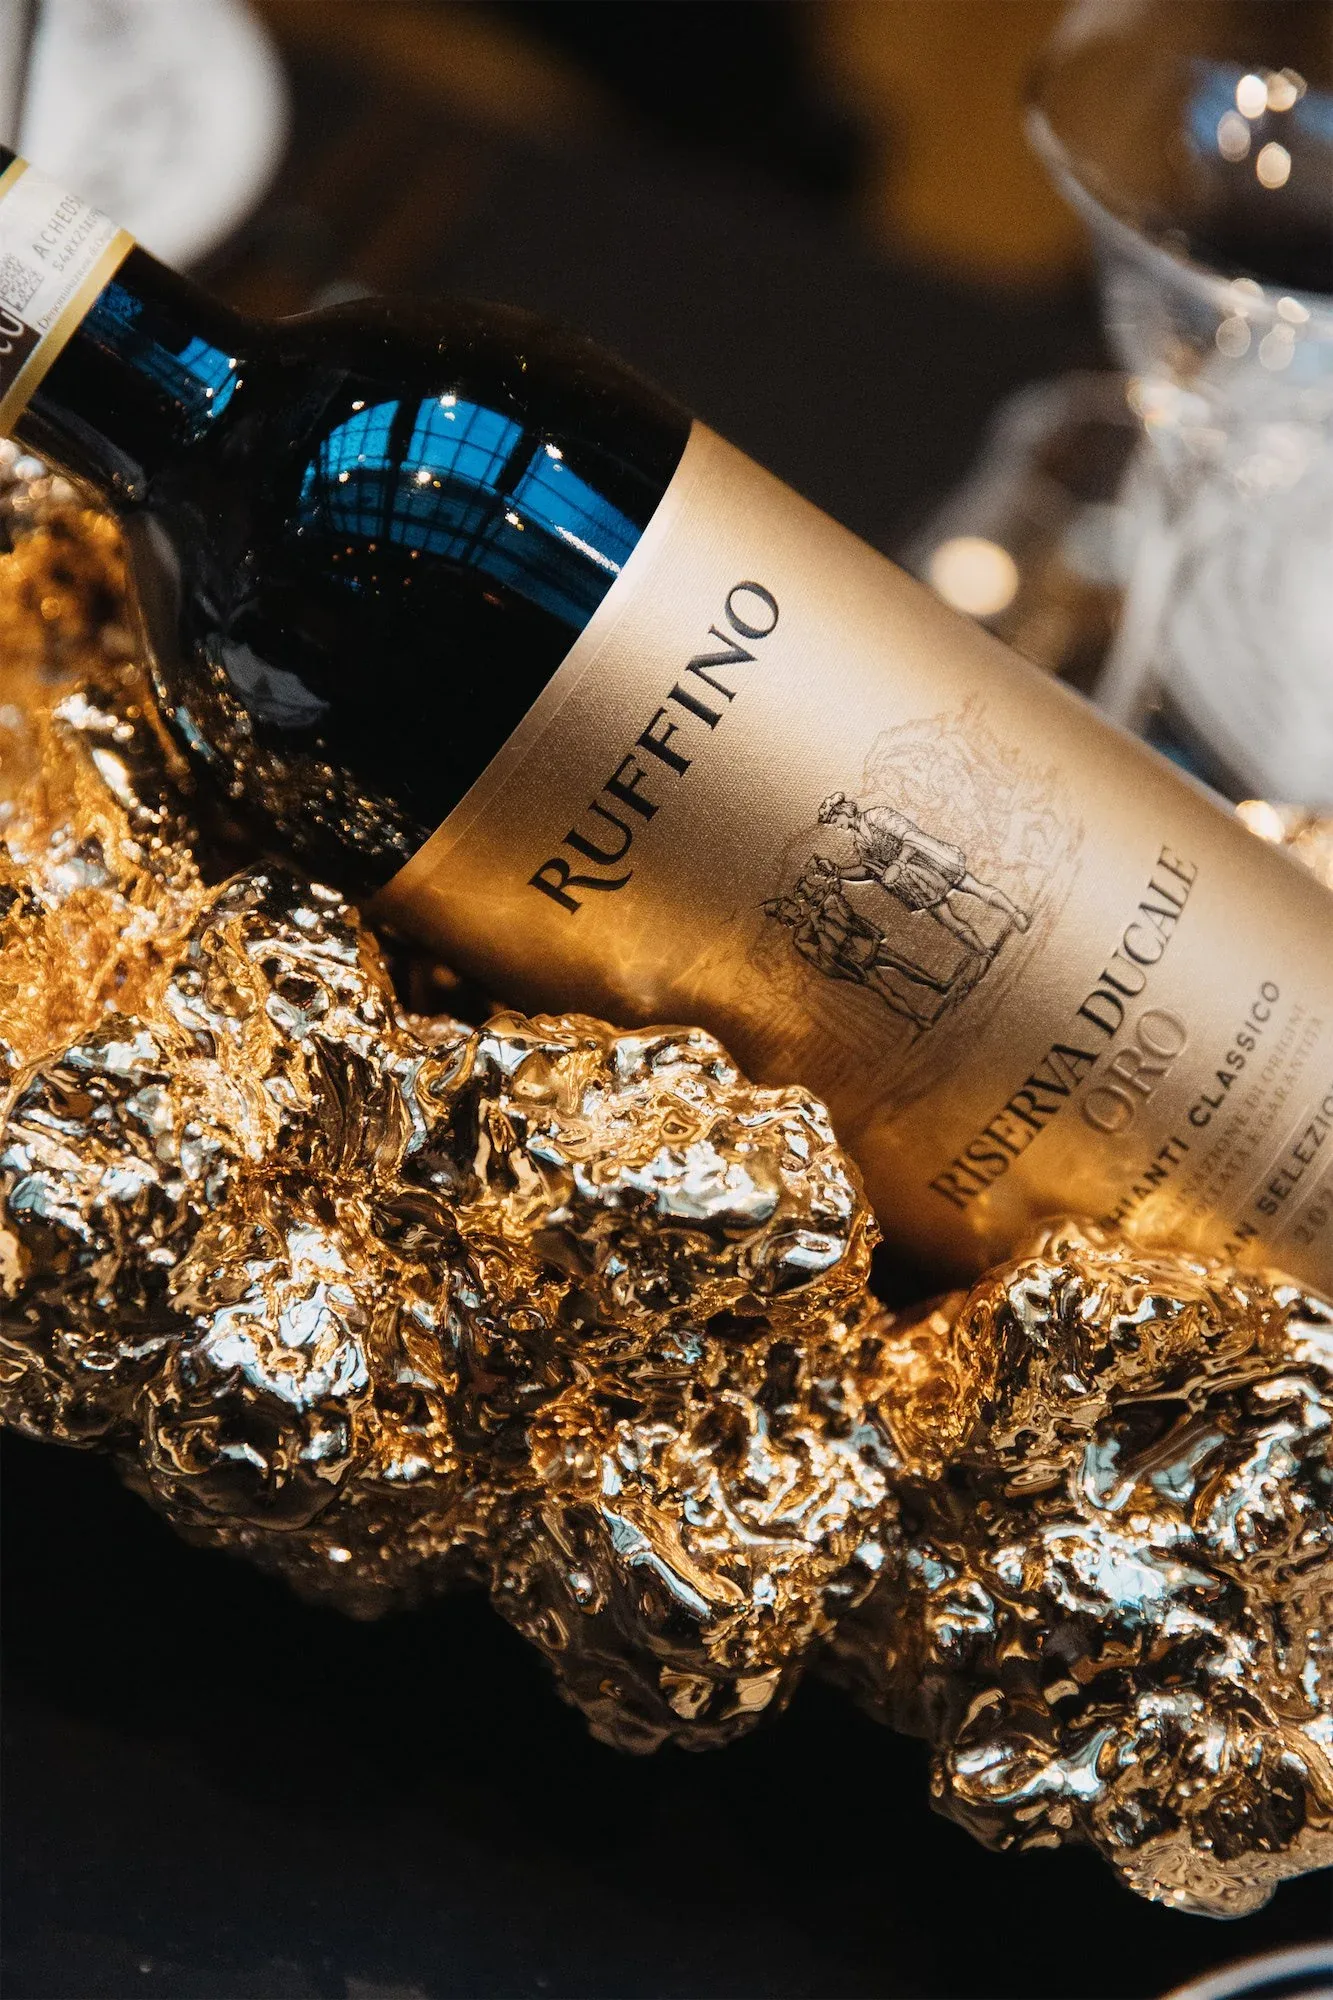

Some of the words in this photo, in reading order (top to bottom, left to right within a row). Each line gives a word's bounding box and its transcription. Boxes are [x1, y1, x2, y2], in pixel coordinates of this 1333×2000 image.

[527, 580, 779, 915] RUFFINO
[929, 1043, 1100, 1210] RISERVA
[1076, 845, 1199, 1038] DUCALE
[1081, 1006, 1188, 1135] ORO
[1188, 981, 1280, 1127] CLASSICO
[1256, 1083, 1333, 1216] SELEZIO
